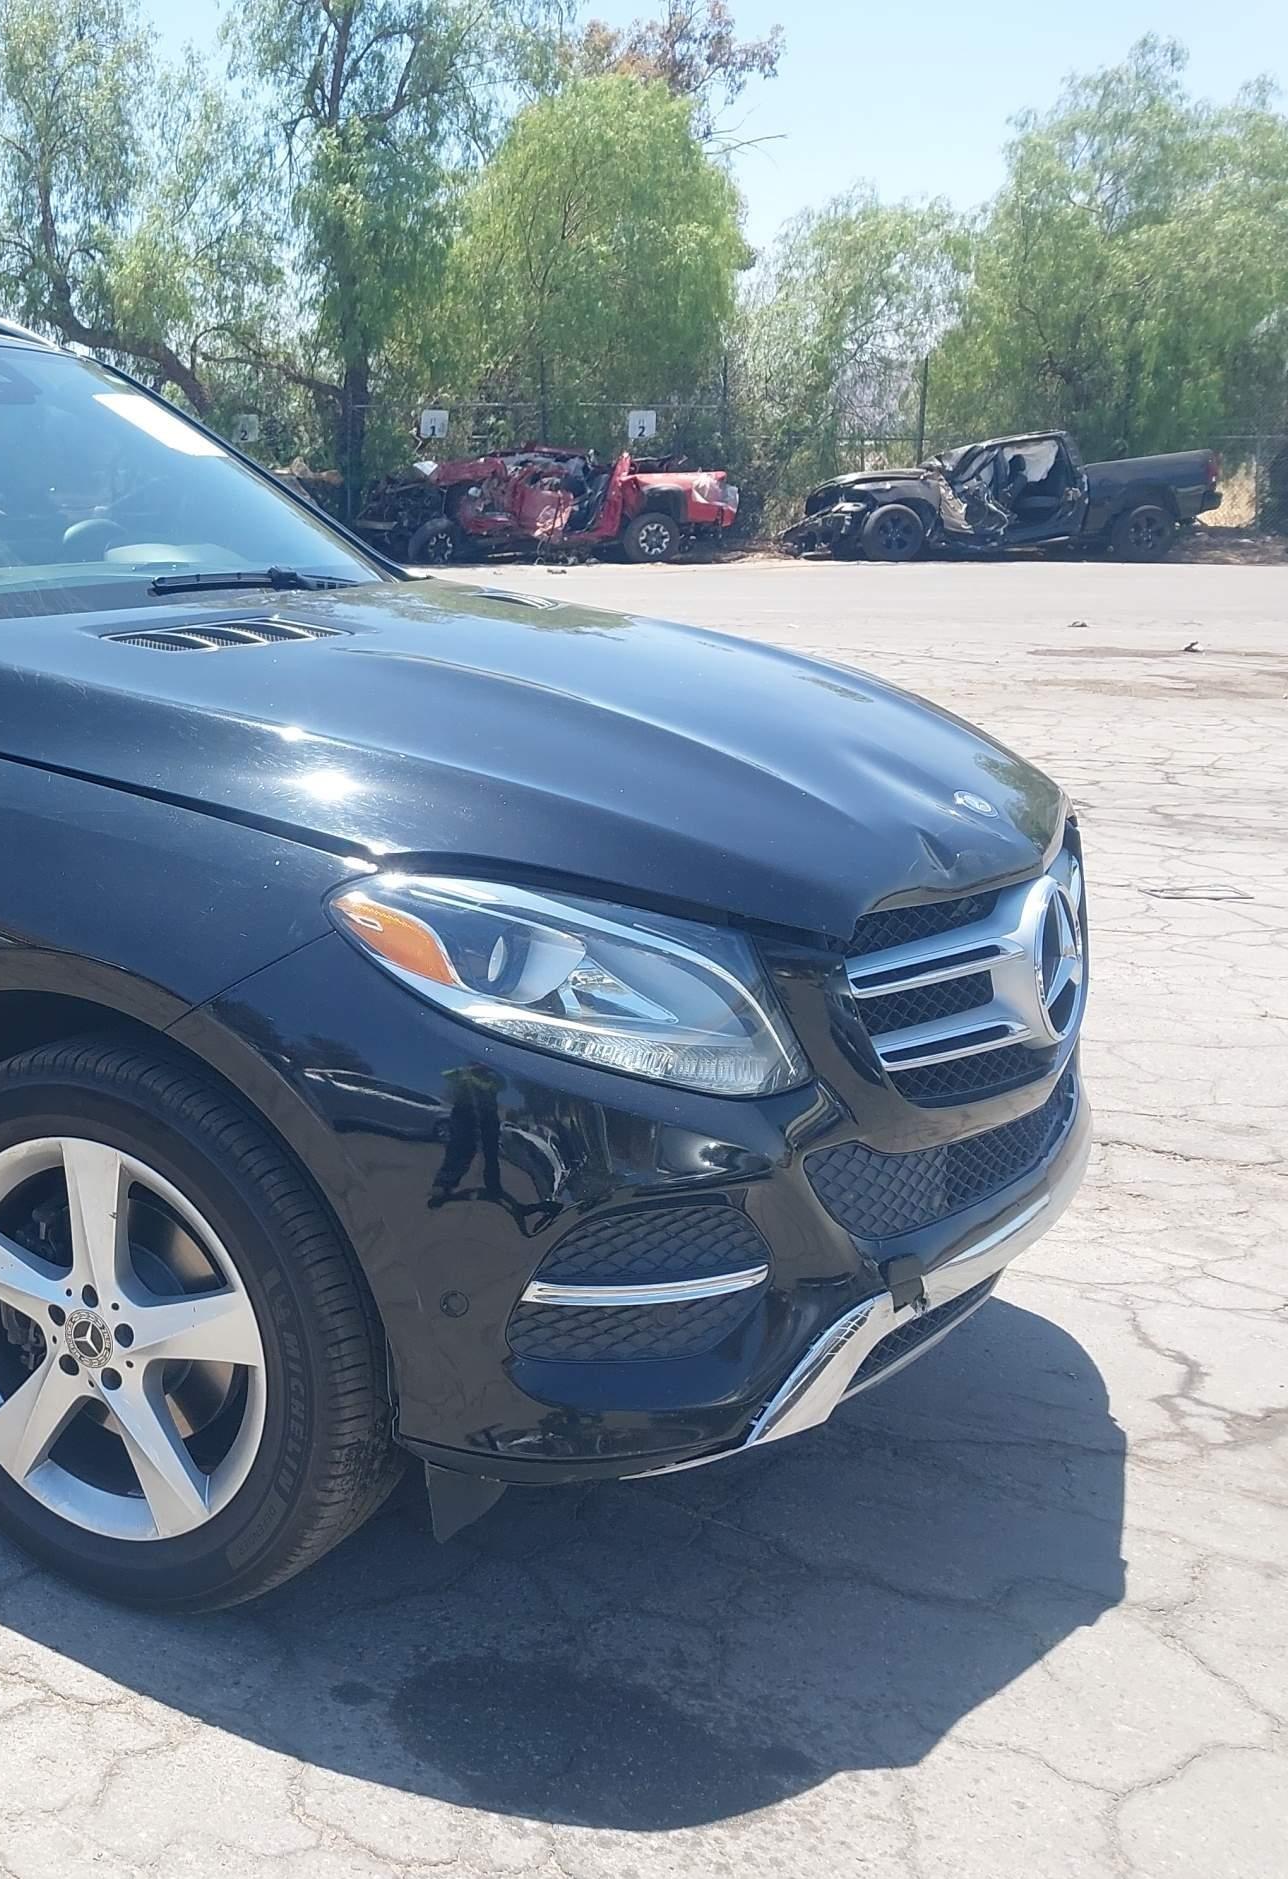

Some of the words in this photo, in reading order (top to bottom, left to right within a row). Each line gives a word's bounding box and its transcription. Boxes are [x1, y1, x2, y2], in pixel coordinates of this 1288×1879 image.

[240, 429, 249, 441] 2
[638, 425, 646, 438] 2
[278, 1331, 306, 1494] MICHELIN
